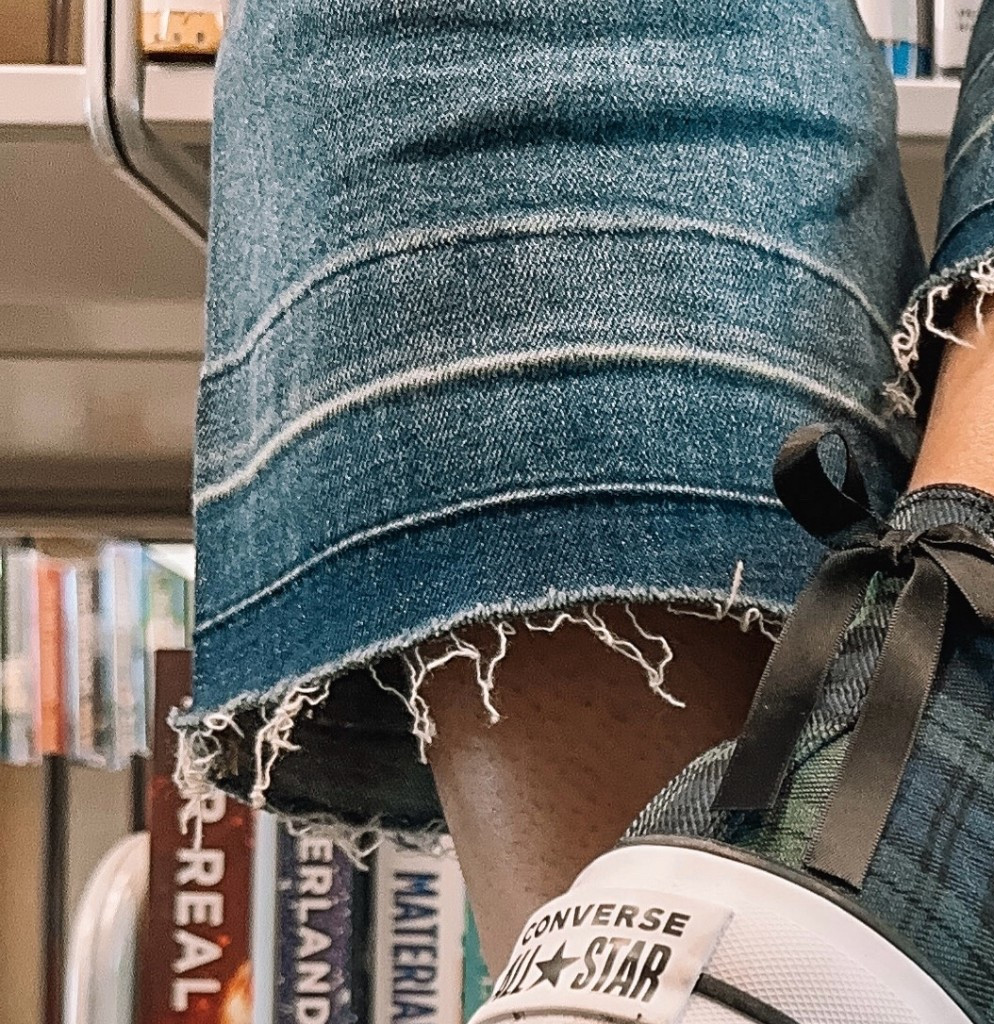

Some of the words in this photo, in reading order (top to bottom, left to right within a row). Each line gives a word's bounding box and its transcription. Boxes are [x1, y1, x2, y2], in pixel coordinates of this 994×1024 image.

[172, 847, 225, 1013] REAL
[521, 903, 692, 946] CONVERSE
[492, 945, 542, 1001] ALL
[569, 936, 673, 1004] STAR
